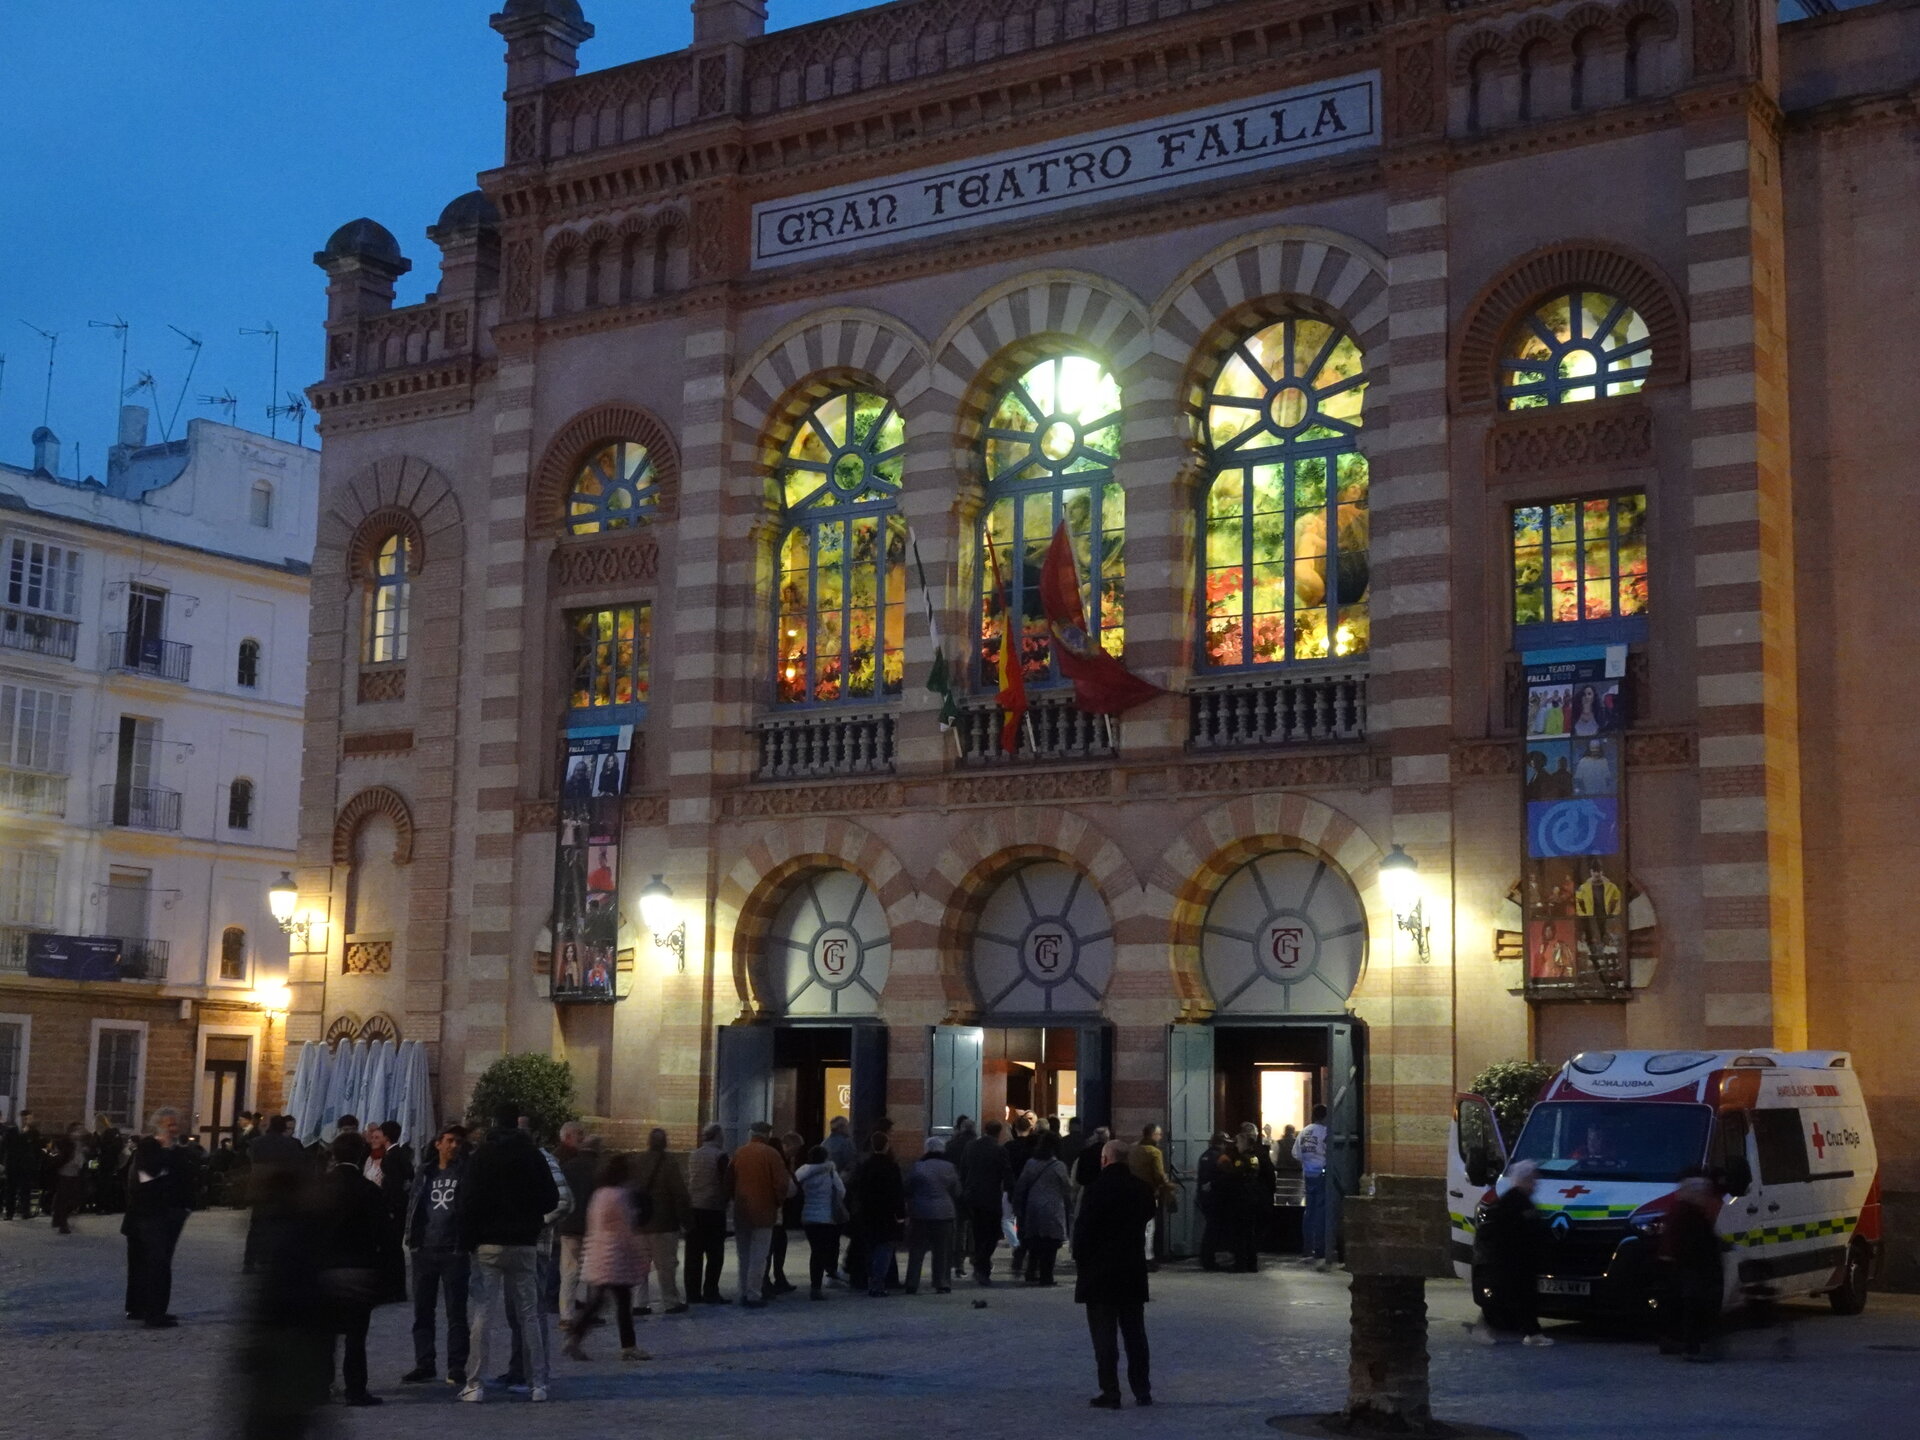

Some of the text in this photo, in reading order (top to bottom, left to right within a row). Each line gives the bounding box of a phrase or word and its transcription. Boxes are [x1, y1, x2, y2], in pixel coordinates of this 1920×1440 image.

[776, 97, 1348, 246] GRAN TEATRO FALLA
[1548, 664, 1576, 673] TEATRO
[1527, 674, 1551, 683] FALLA
[1826, 1128, 1861, 1149] Cruz Roja
